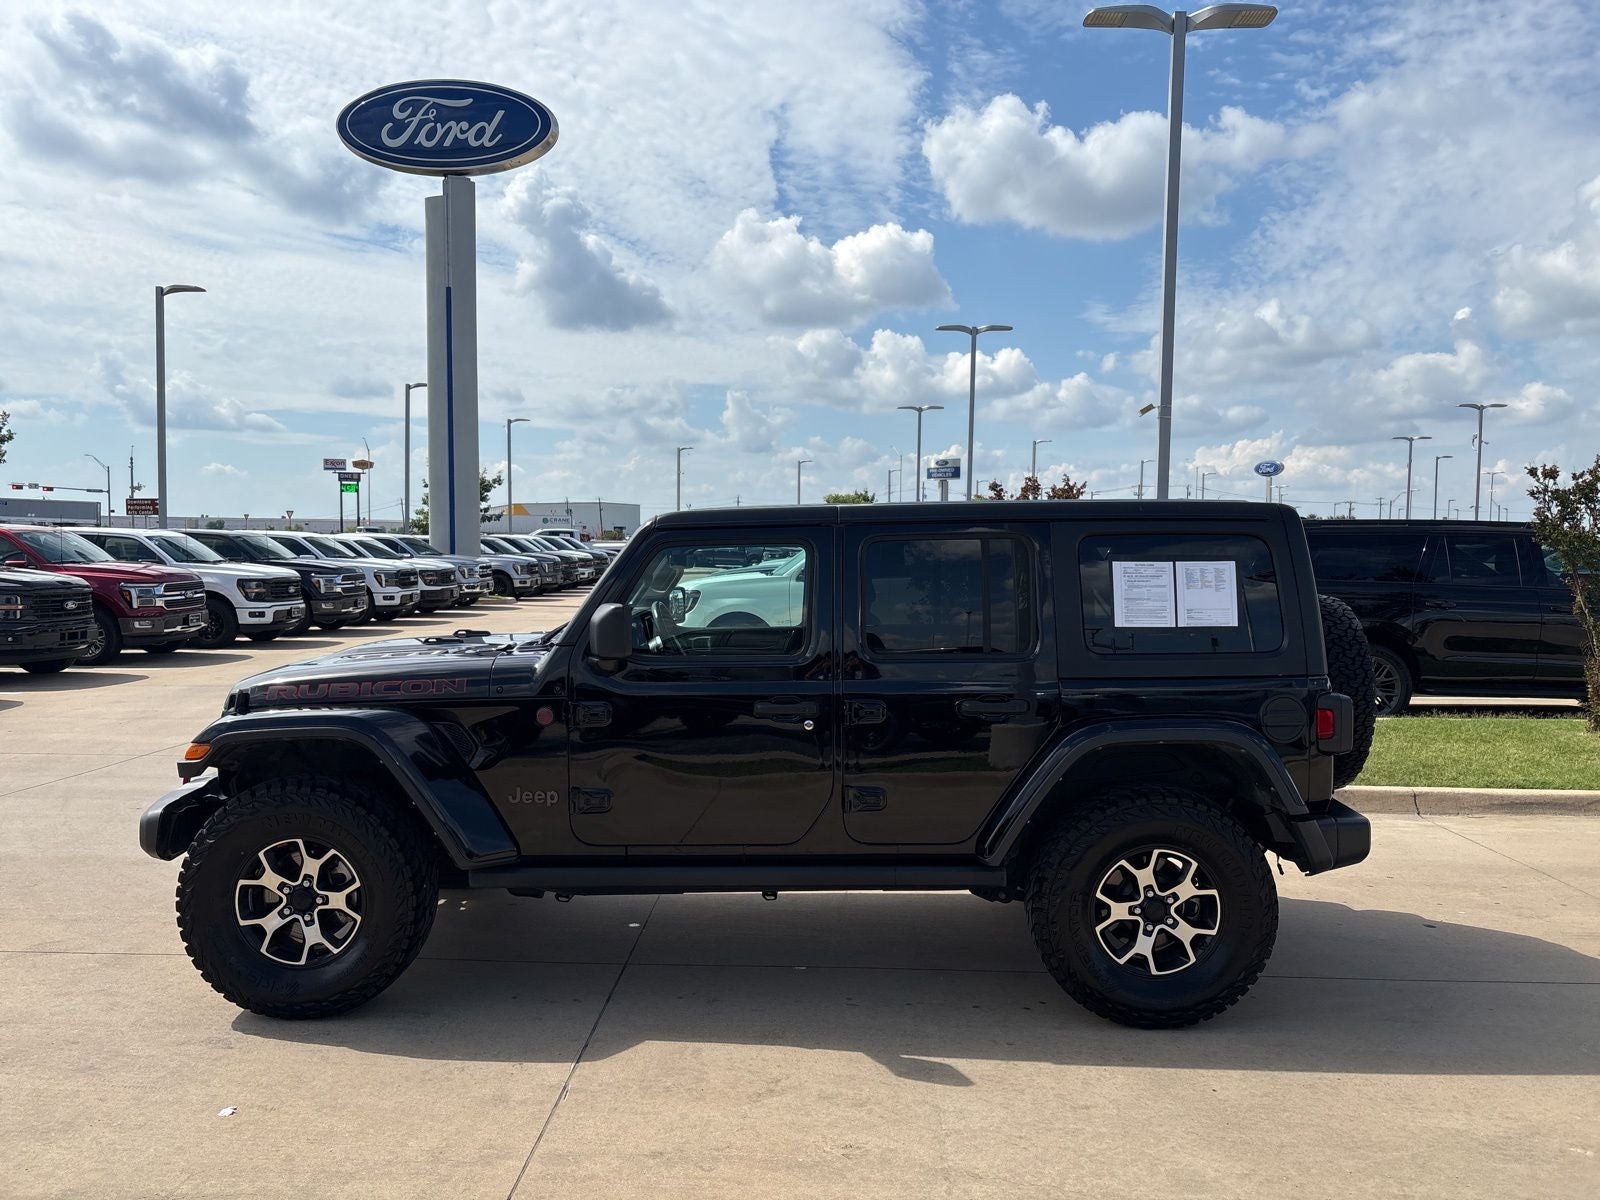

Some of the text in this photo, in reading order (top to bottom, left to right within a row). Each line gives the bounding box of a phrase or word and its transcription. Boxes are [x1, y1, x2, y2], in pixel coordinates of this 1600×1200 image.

[381, 96, 505, 148] Ford
[326, 460, 344, 468] Exxon
[1258, 463, 1275, 473] Ford
[265, 678, 469, 700] RUBICON
[508, 787, 559, 807] Jeep
